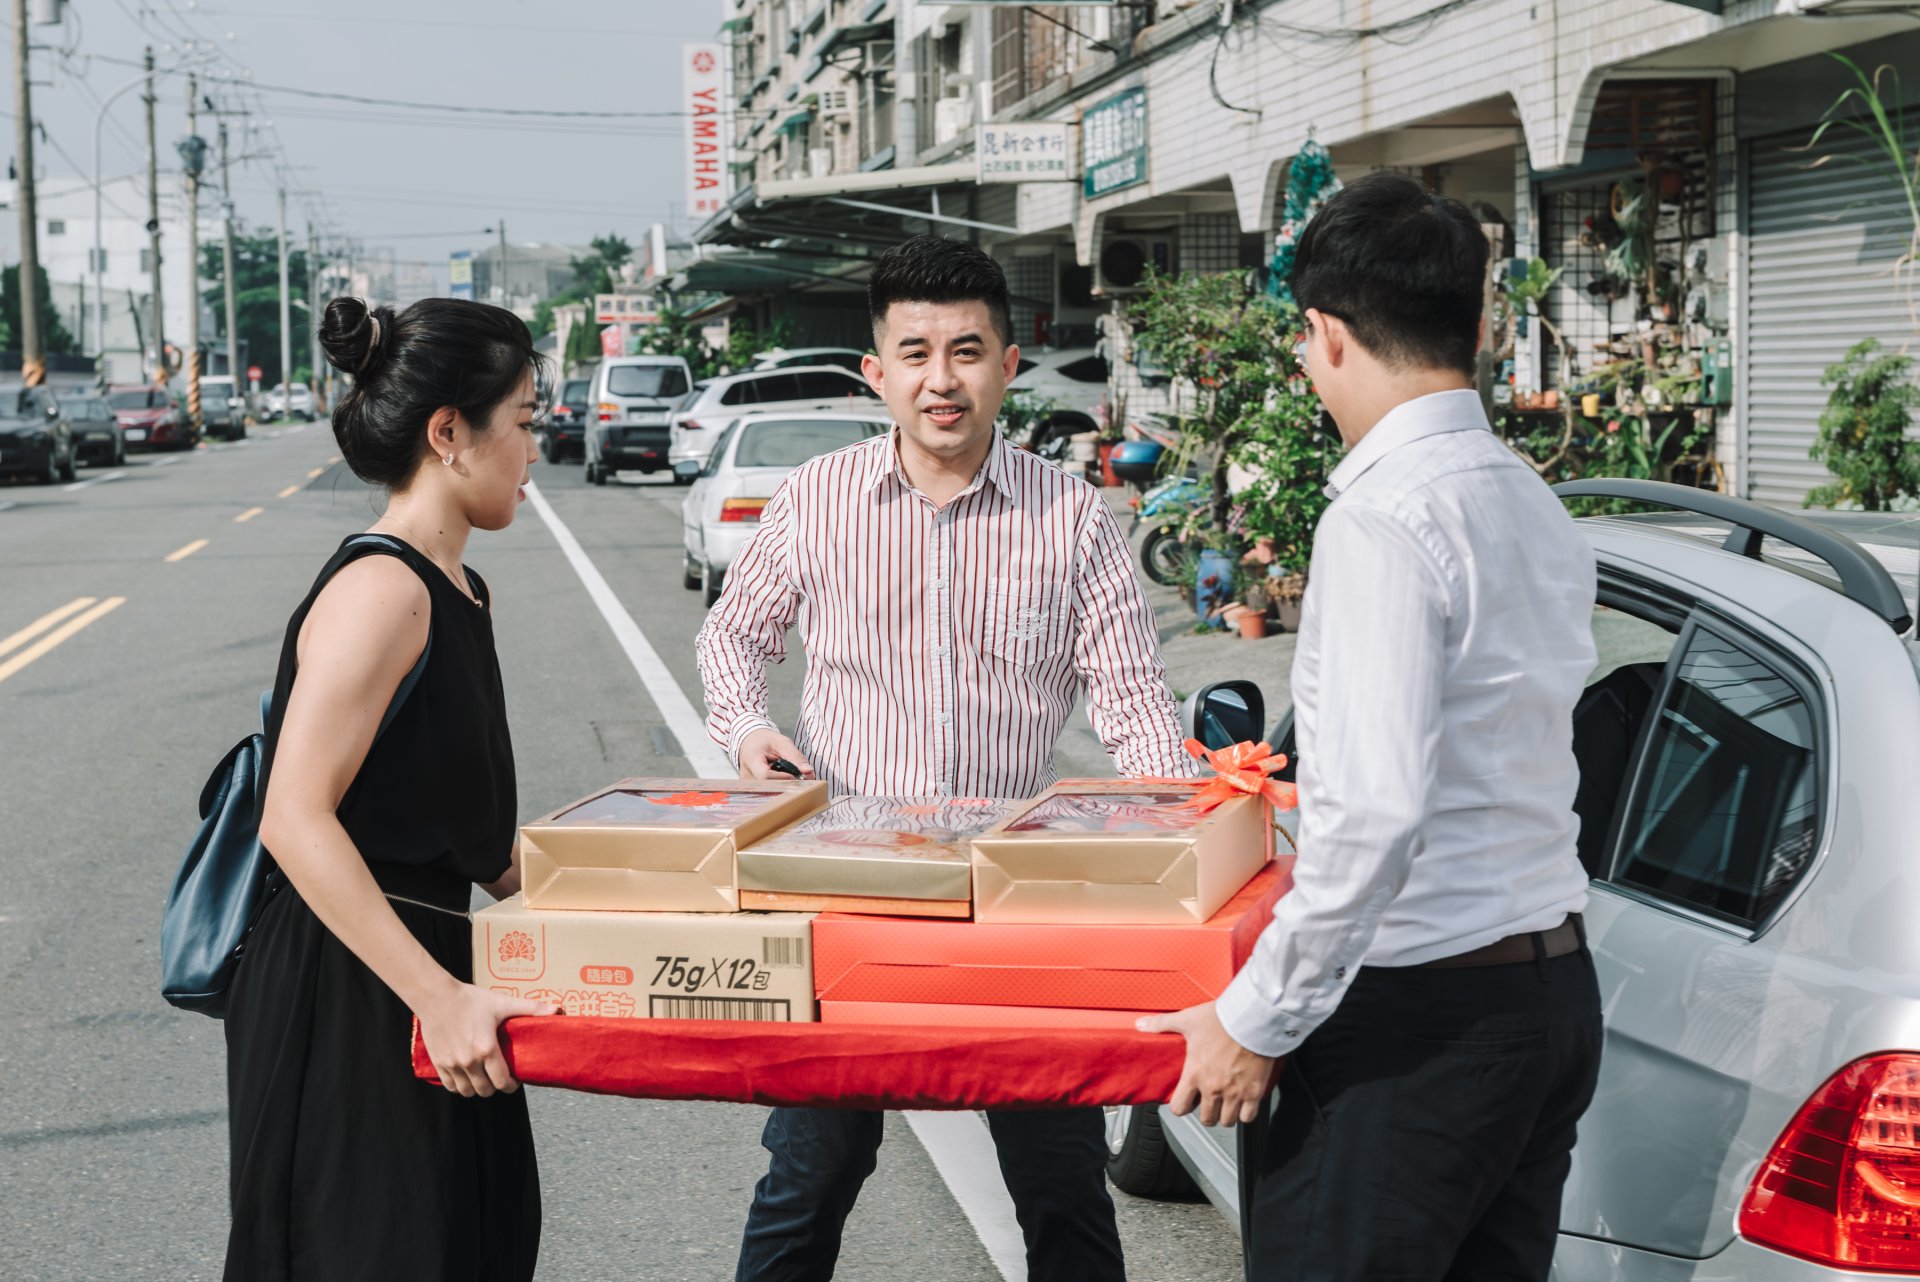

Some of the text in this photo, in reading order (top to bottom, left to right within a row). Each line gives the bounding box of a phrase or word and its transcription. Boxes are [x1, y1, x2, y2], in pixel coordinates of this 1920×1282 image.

[692, 88, 719, 190] YAMAHA
[586, 968, 628, 984] 隨身包
